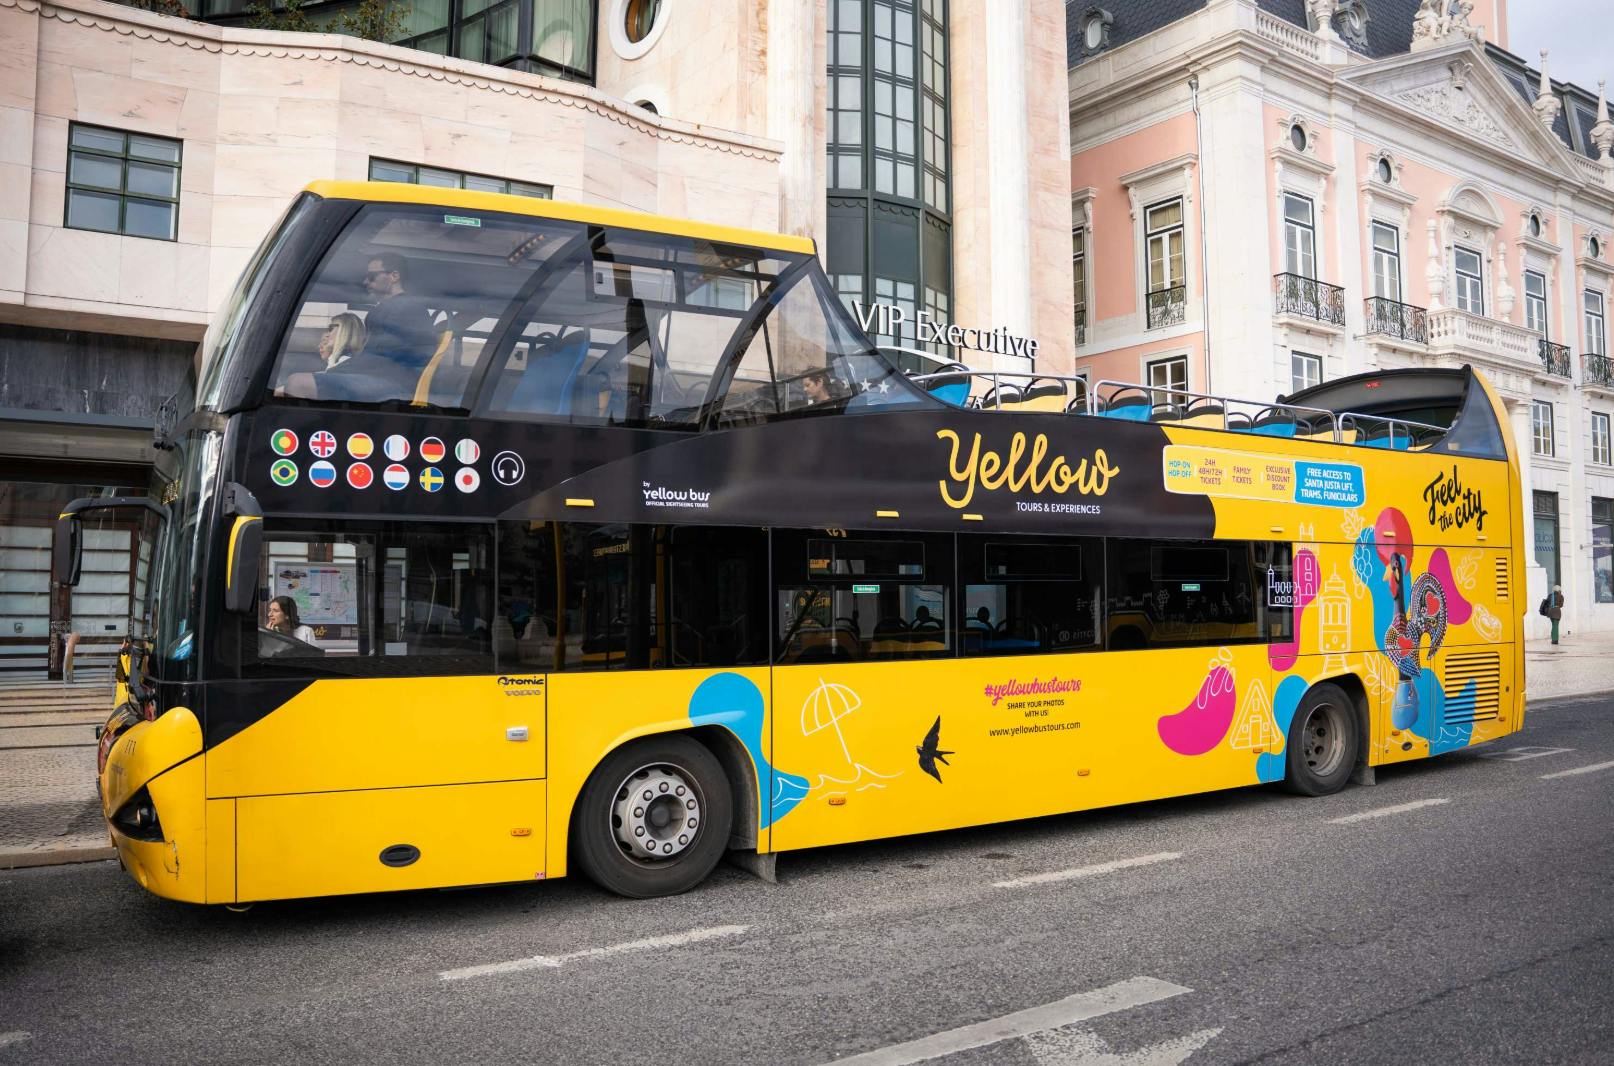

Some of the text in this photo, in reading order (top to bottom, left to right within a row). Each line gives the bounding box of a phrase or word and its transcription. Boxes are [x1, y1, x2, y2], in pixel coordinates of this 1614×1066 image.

[852, 299, 1041, 360] VIP Executive
[1204, 458, 1216, 467] 24H
[1233, 465, 1252, 475] FAMILY
[1265, 465, 1291, 475] EXCLUSIVE
[1307, 467, 1352, 481] FREE ACCESS TO
[1200, 476, 1222, 486] TICKETS
[1232, 475, 1252, 485] TICKETS
[1266, 474, 1291, 484] DISCOUNT
[1304, 478, 1324, 489] SANTA
[1324, 480, 1341, 491] JUSTA
[1271, 483, 1286, 492] BOOK
[689, 488, 711, 502] bus
[1301, 488, 1358, 503] TRAMS, FUNICULARS
[1423, 464, 1462, 526] Feel
[1016, 501, 1101, 514] TOURS & EXPERIENCES
[1438, 511, 1454, 532] the
[985, 677, 1082, 706] #yellowbustours
[989, 721, 1081, 737] www.yellowbustours.com
